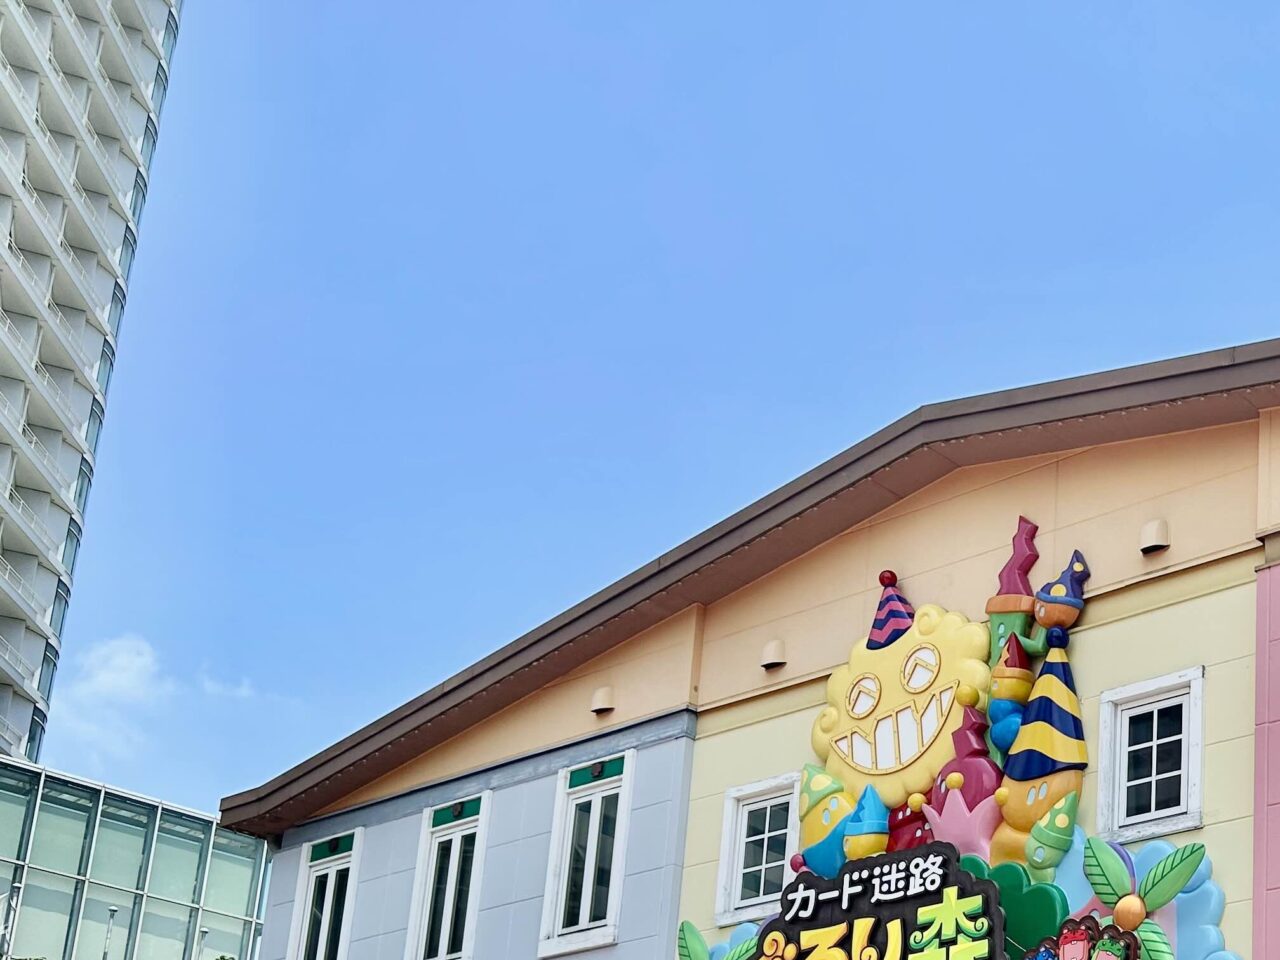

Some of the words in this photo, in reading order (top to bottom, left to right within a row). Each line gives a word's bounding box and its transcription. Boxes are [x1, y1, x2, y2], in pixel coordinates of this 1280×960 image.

[784, 853, 945, 922] カード迷路
